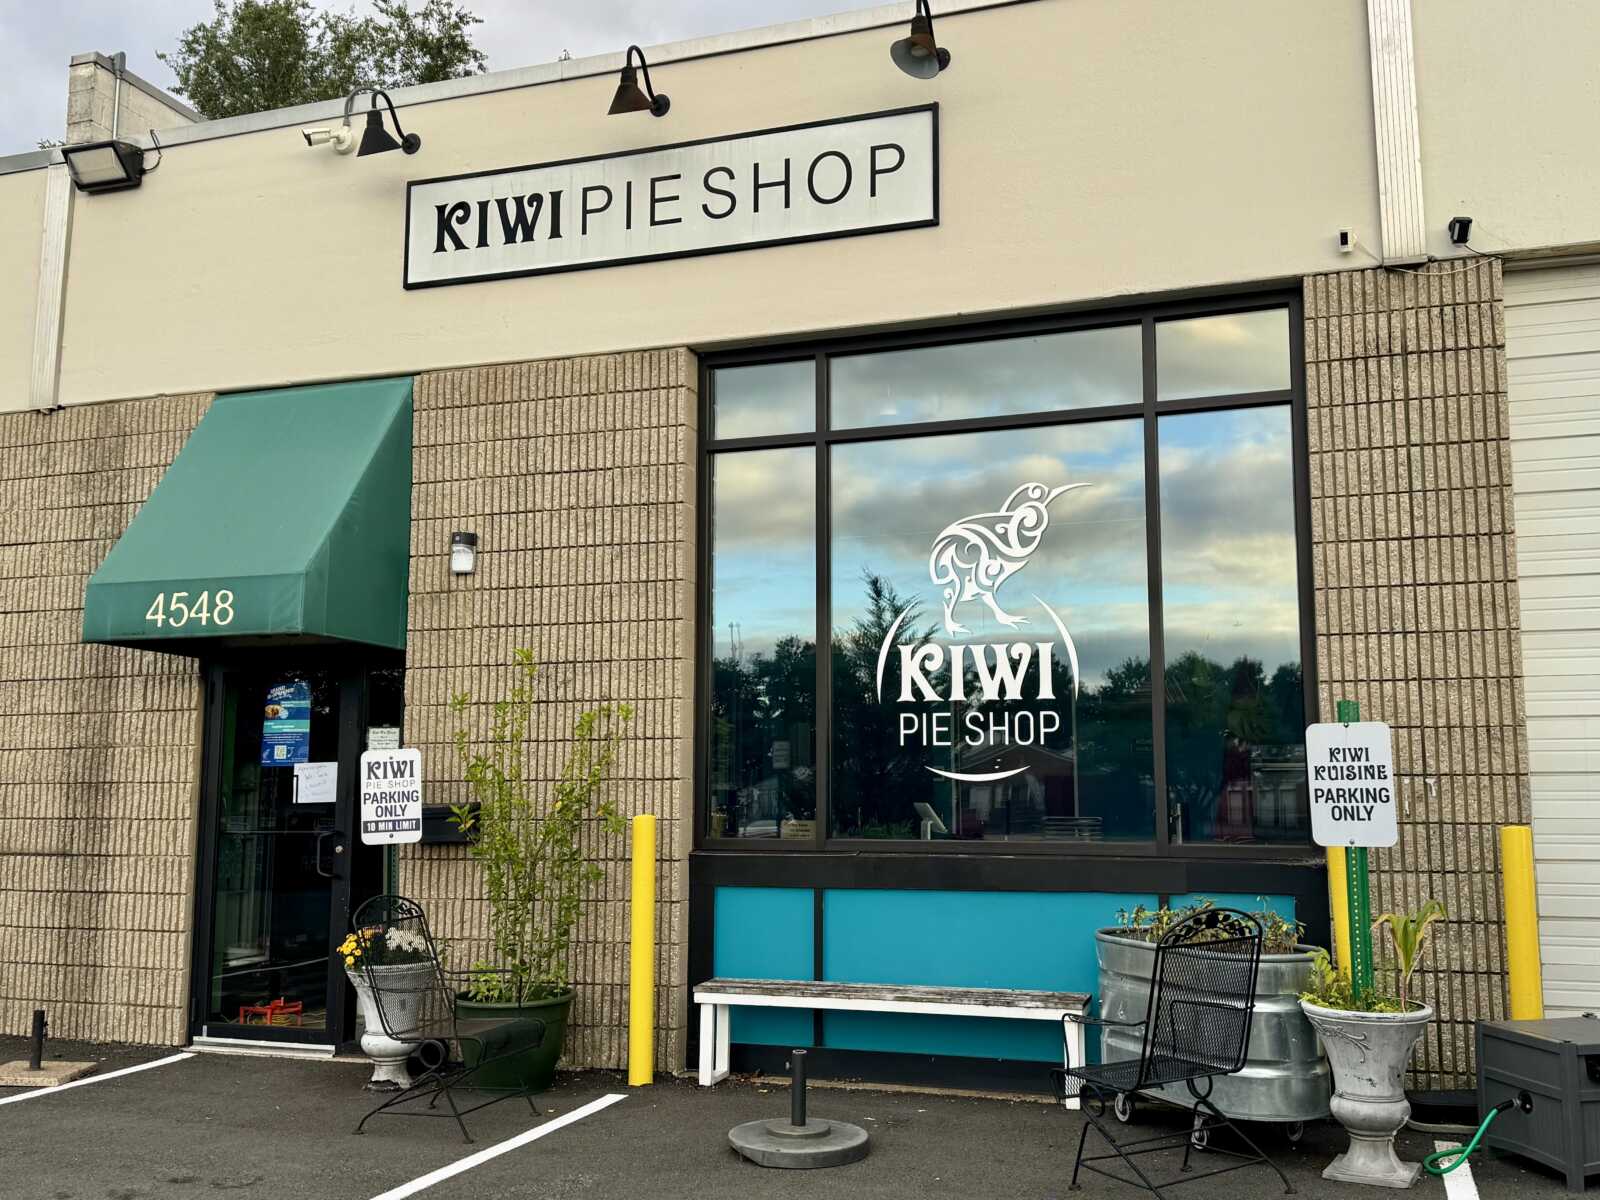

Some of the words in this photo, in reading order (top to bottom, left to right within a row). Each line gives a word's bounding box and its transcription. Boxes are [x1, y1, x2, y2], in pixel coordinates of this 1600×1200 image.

[433, 190, 565, 253] KIWI
[581, 173, 682, 235] PIE
[701, 143, 905, 220] SHOP
[145, 590, 234, 628] 4548
[896, 642, 1057, 702] KIWI
[900, 712, 952, 747] PIE
[965, 710, 1060, 746] SHOP
[1329, 747, 1370, 762] KIWI
[367, 760, 415, 780] KIWI
[1314, 764, 1388, 781] KUISINE
[366, 781, 382, 790] PIE
[388, 779, 416, 789] SHOP
[363, 790, 420, 805] PARKING
[1314, 787, 1391, 804] PARKING
[375, 804, 408, 818] ONLY
[1331, 805, 1375, 821] ONLY
[367, 822, 376, 832] 10
[378, 821, 393, 831] MIN
[396, 820, 417, 831] LIMIT
